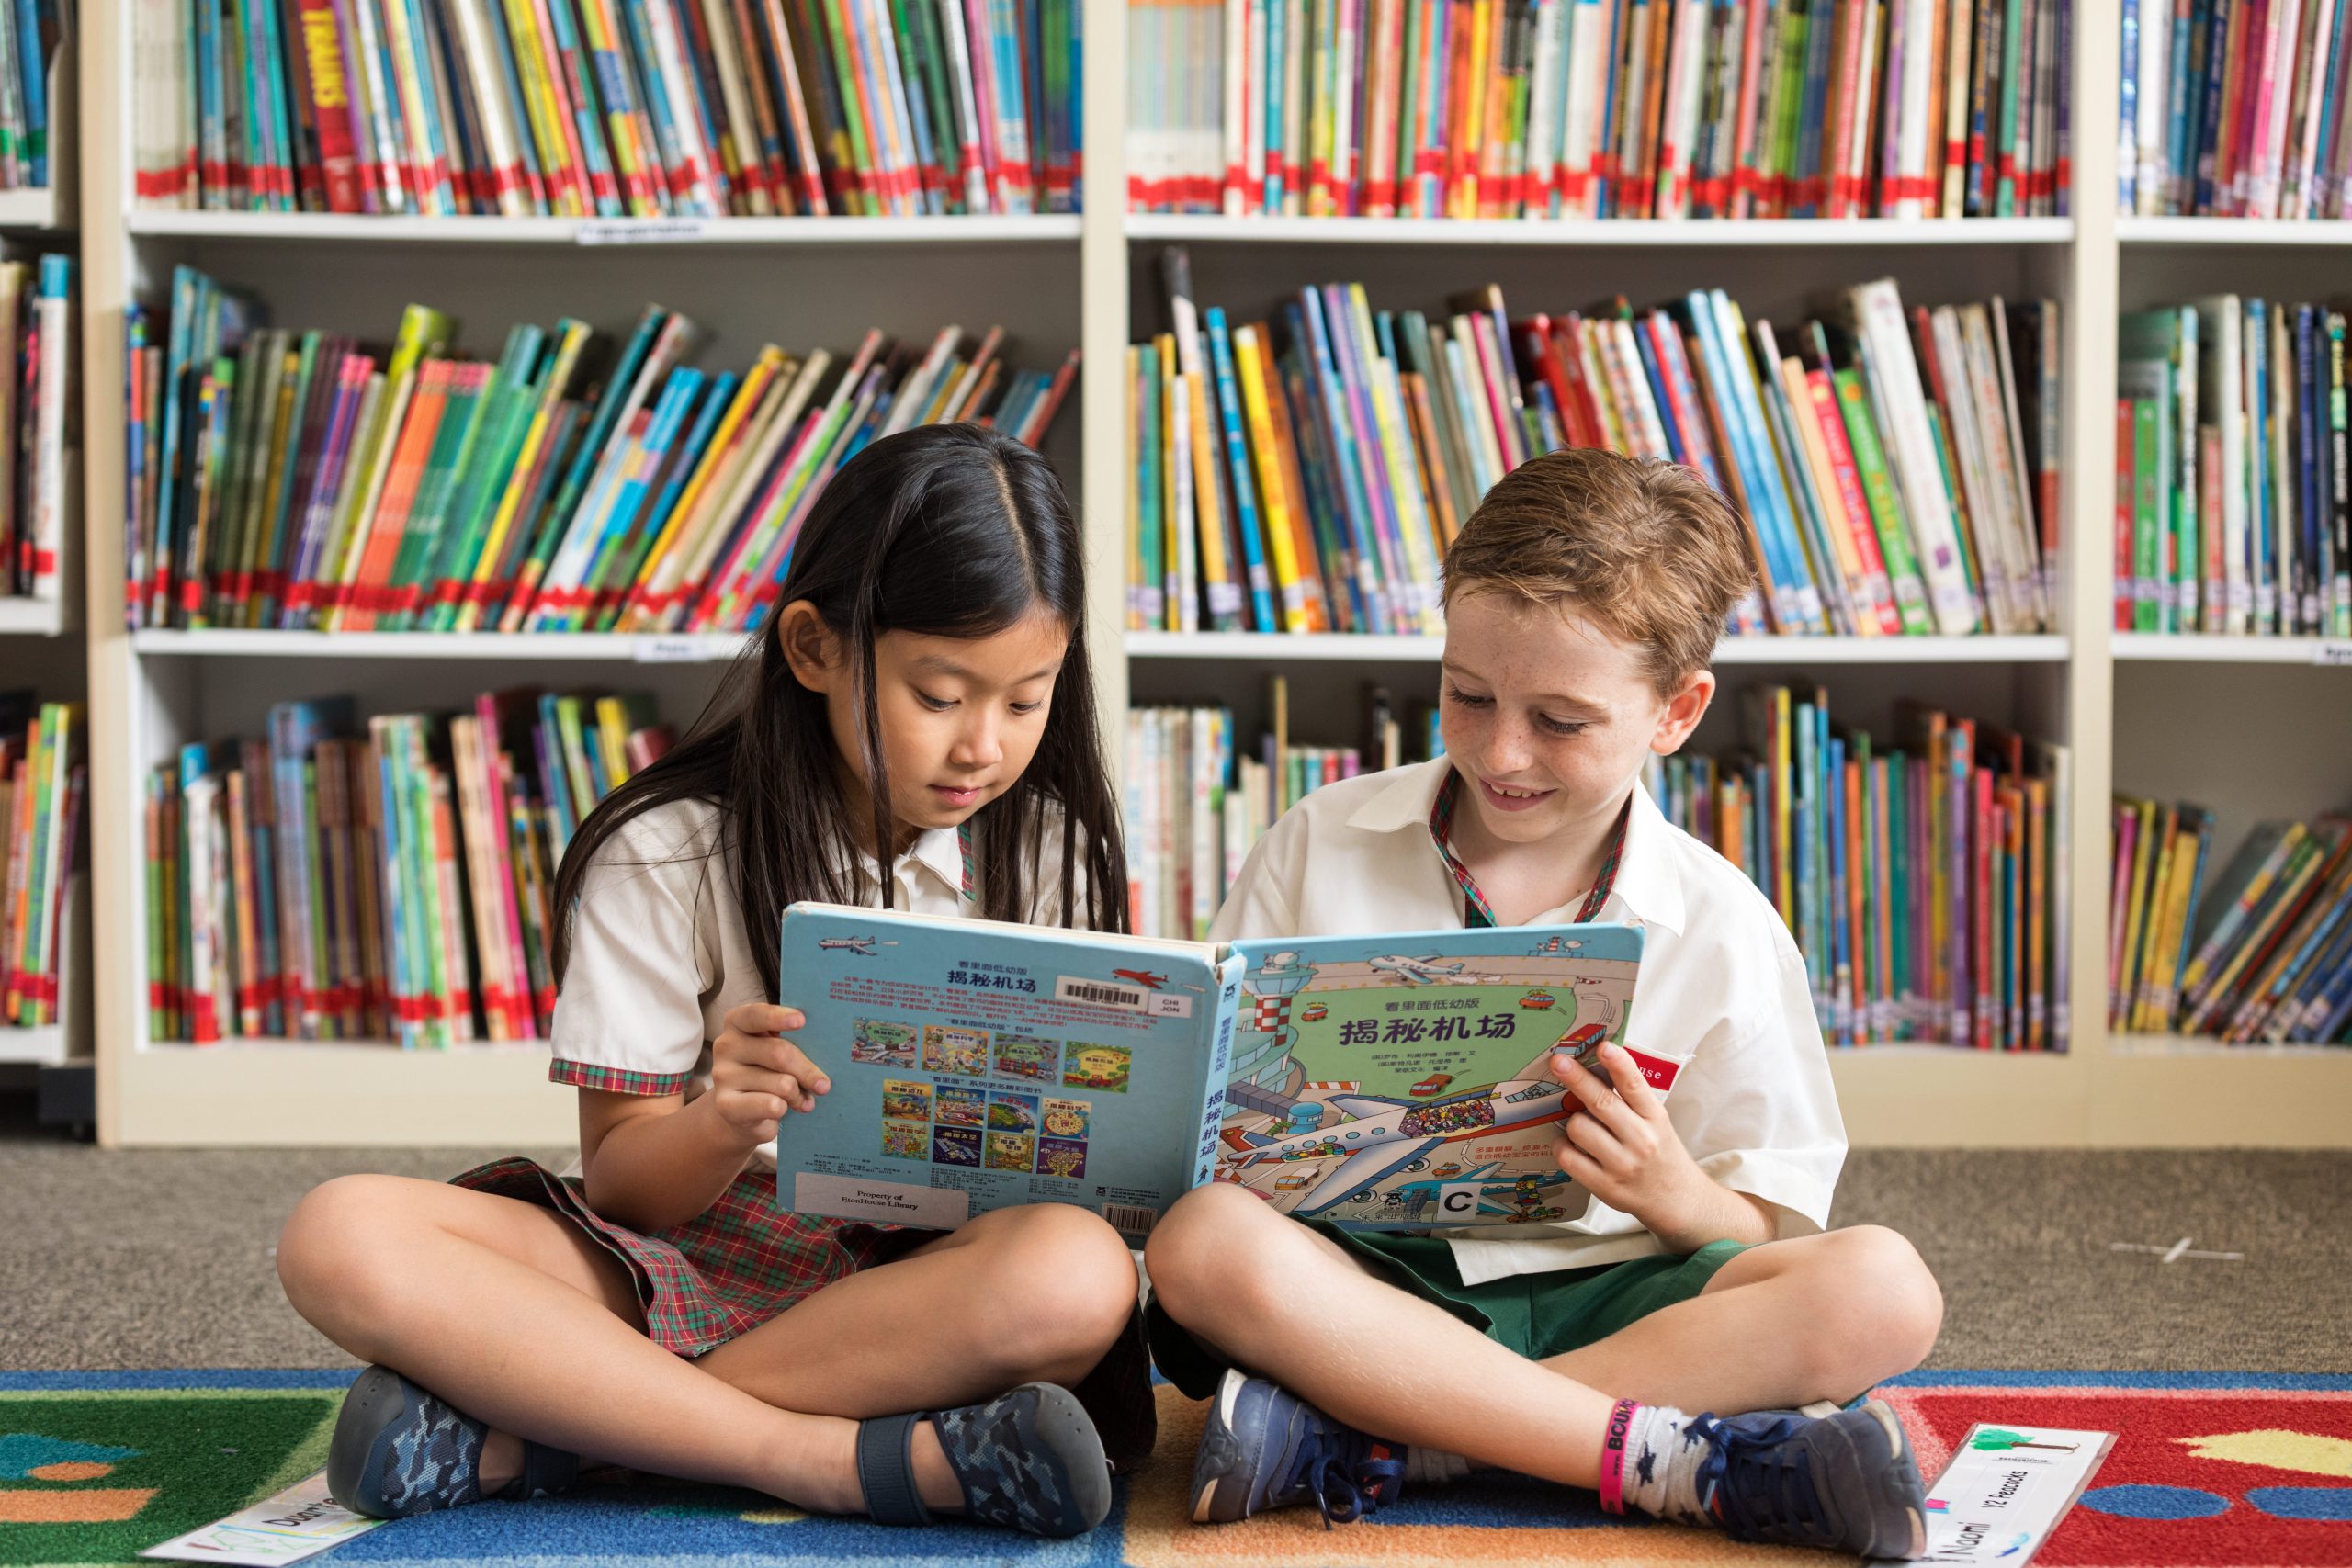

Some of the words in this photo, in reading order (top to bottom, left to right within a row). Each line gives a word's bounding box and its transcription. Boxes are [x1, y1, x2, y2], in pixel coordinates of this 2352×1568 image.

[958, 960, 1028, 975] 看里面低幼版
[947, 970, 1036, 993] 揭秘机场
[1384, 998, 1481, 1012] 看里面低幼版
[1339, 1013, 1516, 1045] 揭秘机场
[1639, 1066, 1662, 1079] use
[1199, 1089, 1224, 1158] 揭秘机场
[842, 1196, 886, 1207] EtonHouse
[888, 1201, 918, 1211] Library
[857, 1190, 892, 1201] Property
[1443, 1191, 1473, 1212] C
[1988, 1471, 2029, 1499] Peacocks
[1938, 1521, 1992, 1556] Naomi
